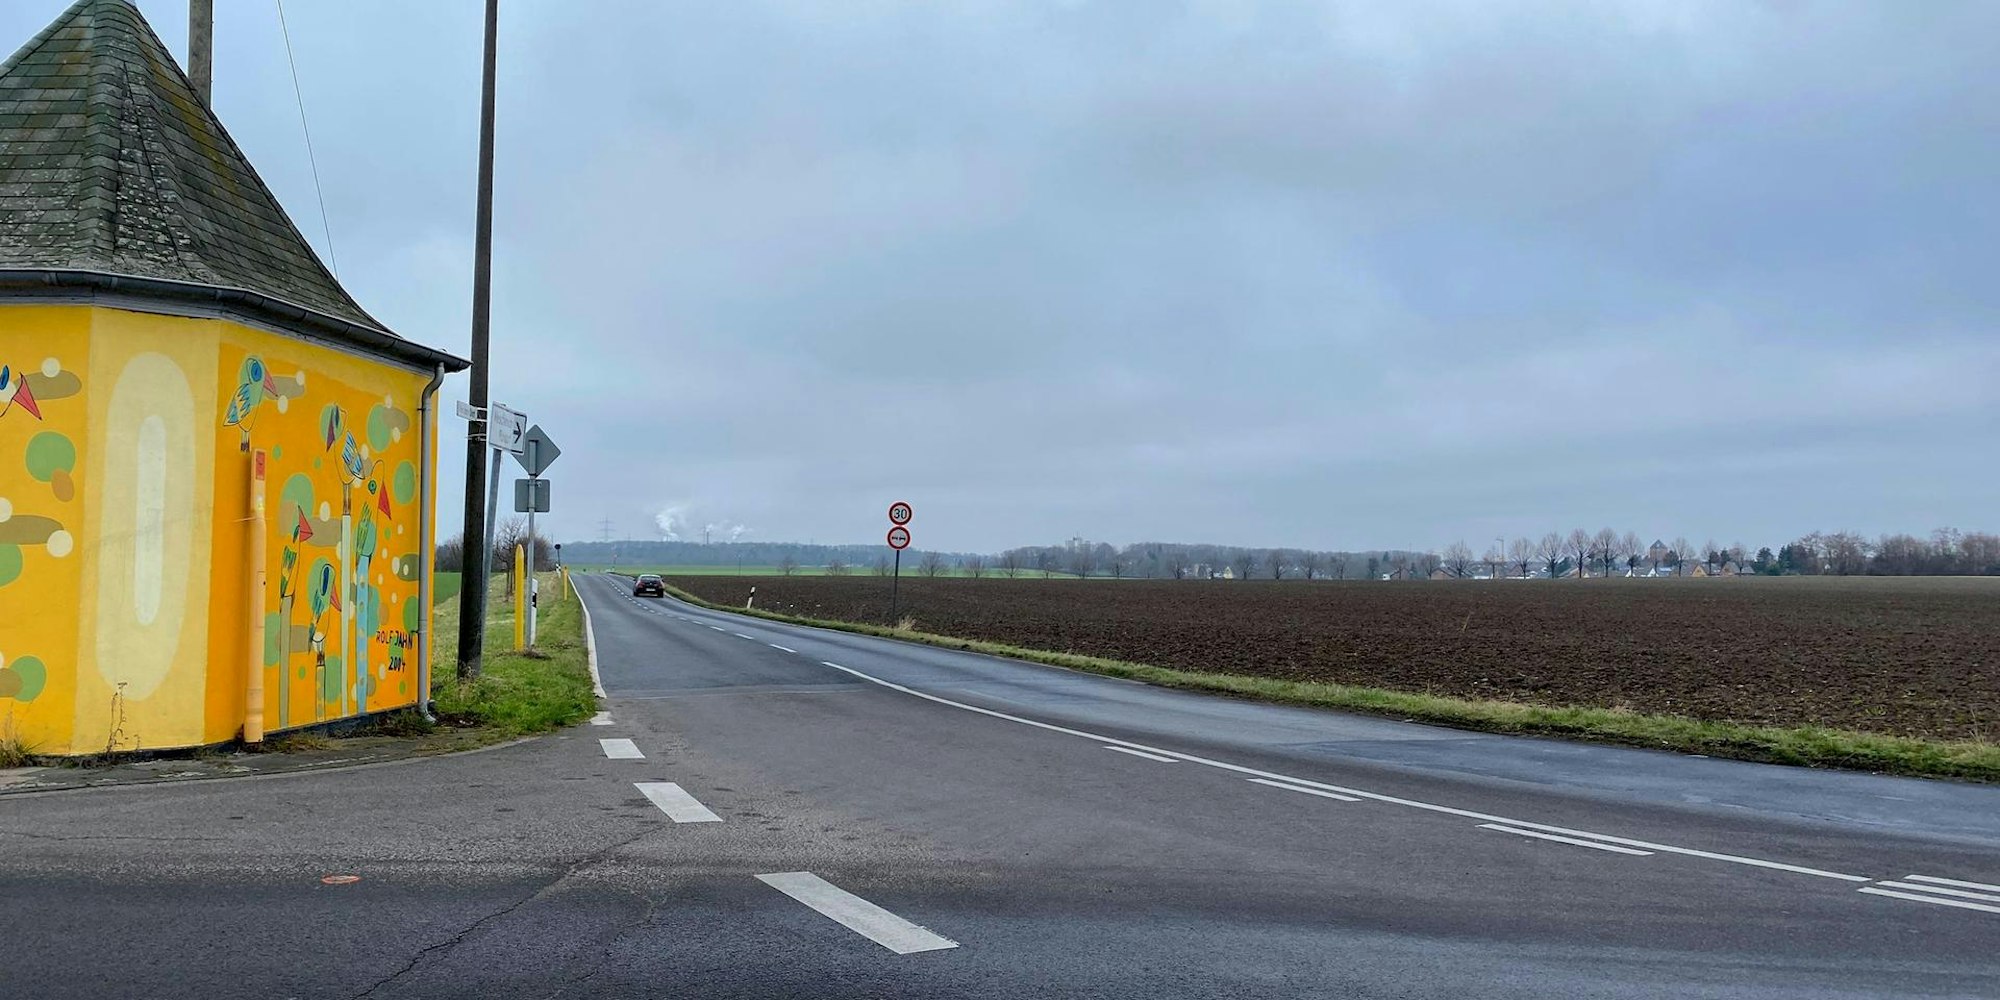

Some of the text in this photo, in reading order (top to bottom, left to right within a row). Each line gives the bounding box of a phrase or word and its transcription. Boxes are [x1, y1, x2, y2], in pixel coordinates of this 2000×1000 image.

[893, 508, 908, 519] 30
[376, 630, 413, 649] ROLF JAHN
[388, 656, 406, 672] 2004
